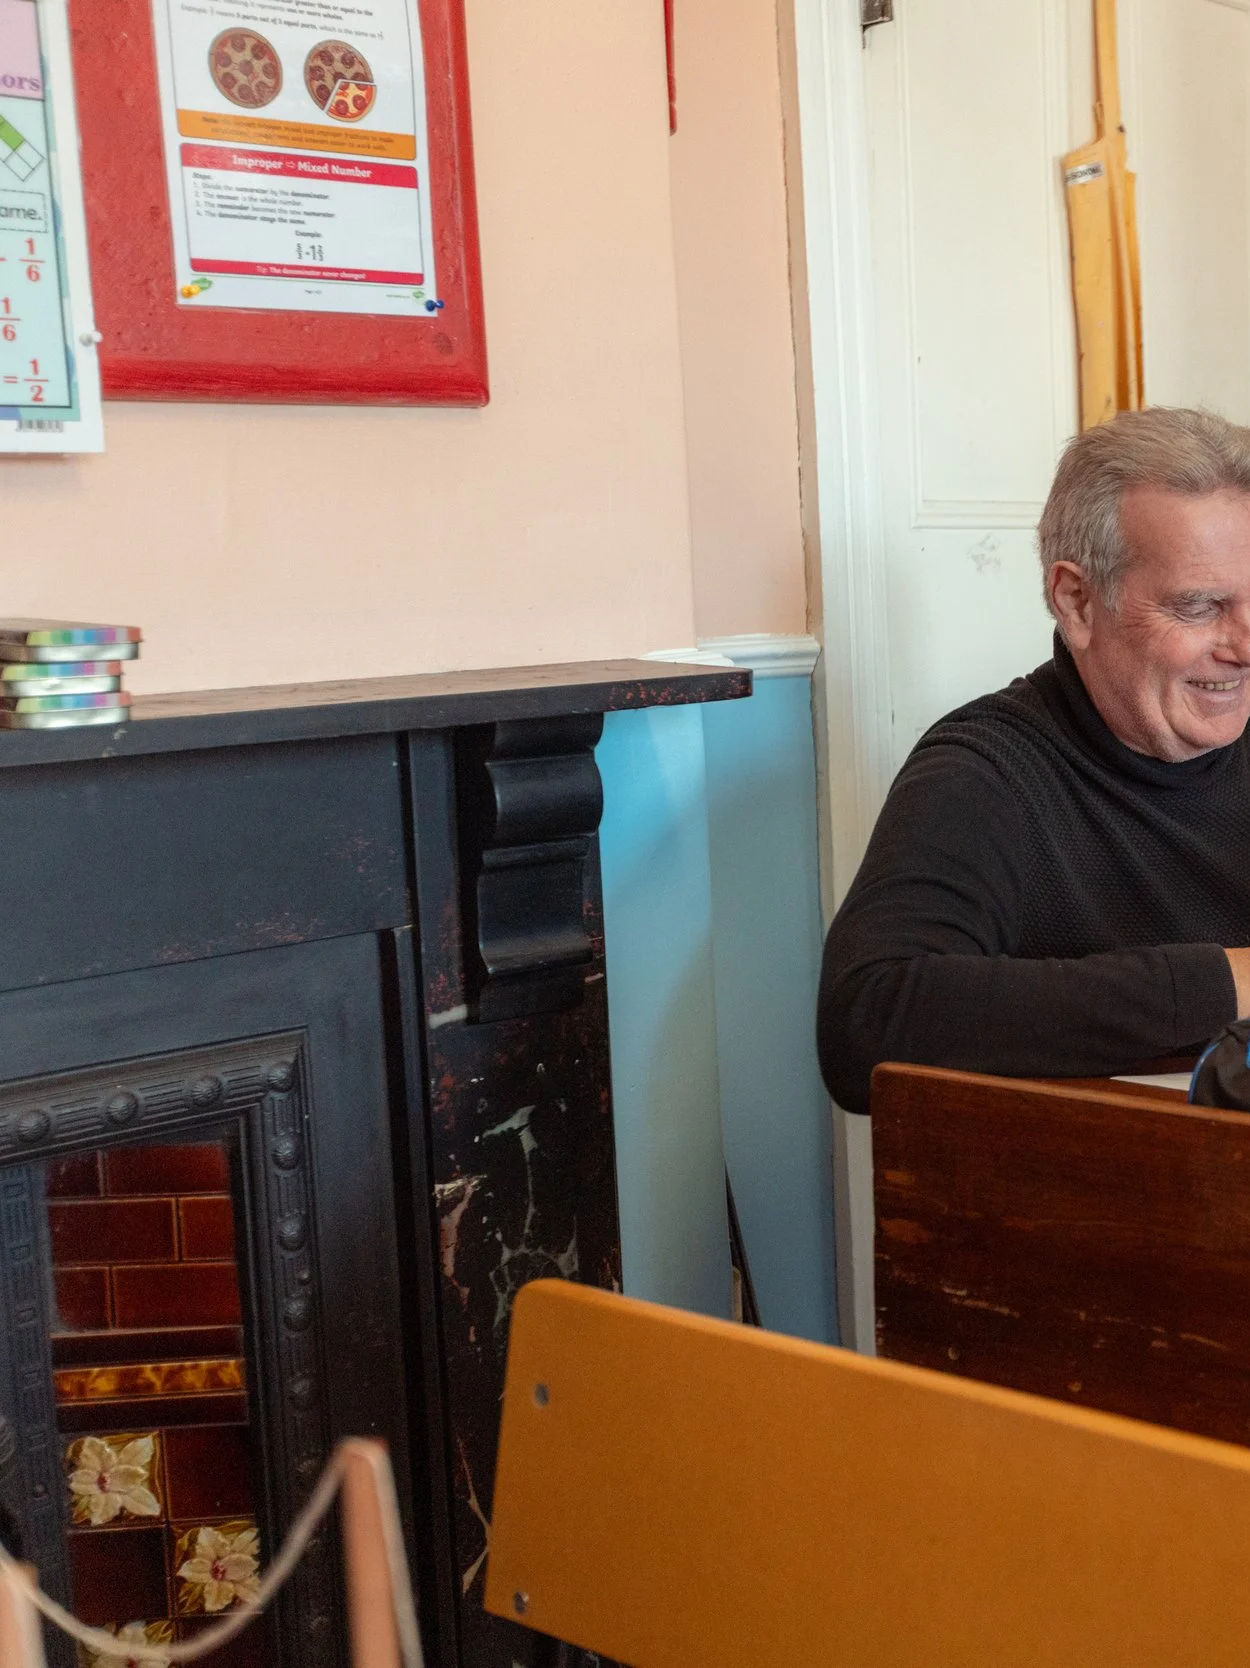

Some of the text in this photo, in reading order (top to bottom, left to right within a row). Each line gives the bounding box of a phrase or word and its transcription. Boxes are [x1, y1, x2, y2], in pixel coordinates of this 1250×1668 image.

[0, 74, 41, 92] ors
[232, 154, 372, 179] Improper Mixed Number
[0, 205, 43, 221] ame.
[26, 264, 41, 283] 6
[2, 324, 17, 342] 6
[30, 385, 45, 403] 2
